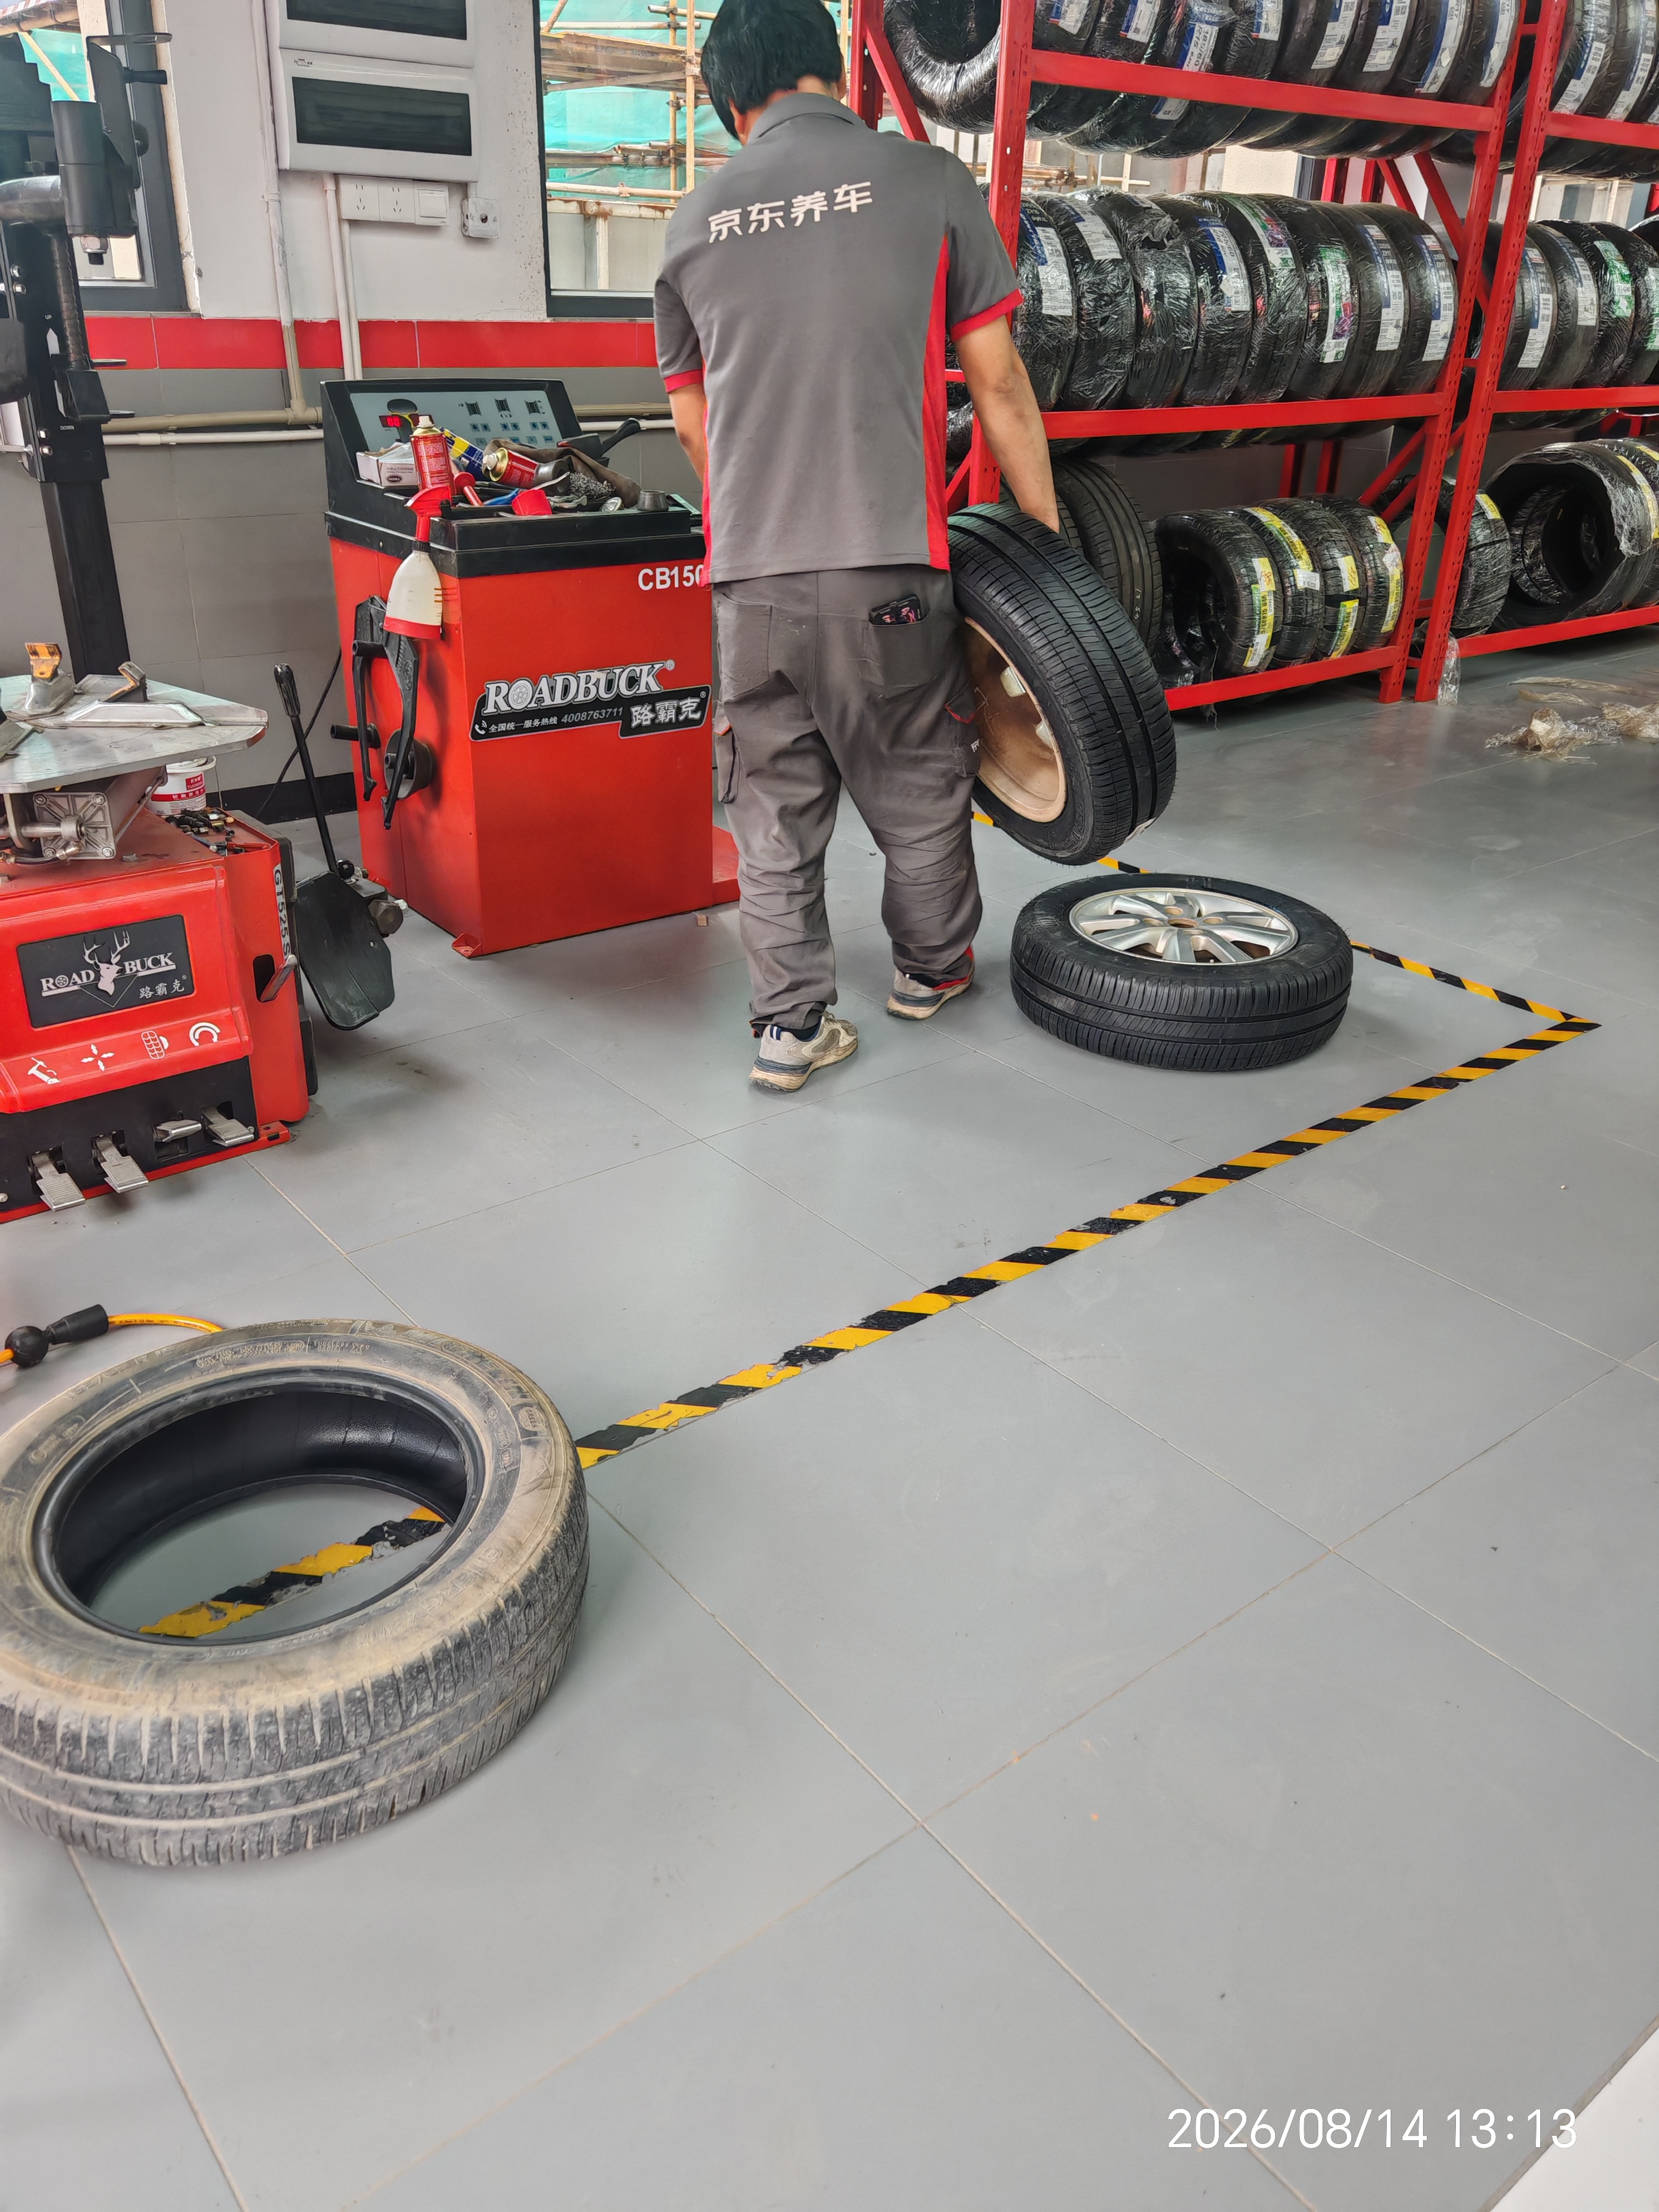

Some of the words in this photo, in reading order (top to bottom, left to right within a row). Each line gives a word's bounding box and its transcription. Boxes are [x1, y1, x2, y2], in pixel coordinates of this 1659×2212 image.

[708, 181, 873, 244] 京东养车
[483, 662, 664, 713] ROADBUCK
[489, 716, 558, 733] 全国统一服务热线
[561, 706, 623, 724] 4008763711
[630, 697, 701, 727] 路霸克
[40, 968, 95, 992] ROAD
[123, 952, 173, 975] BUCK
[139, 979, 185, 1000] 路霸克
[525, 1408, 538, 1429] GREEN
